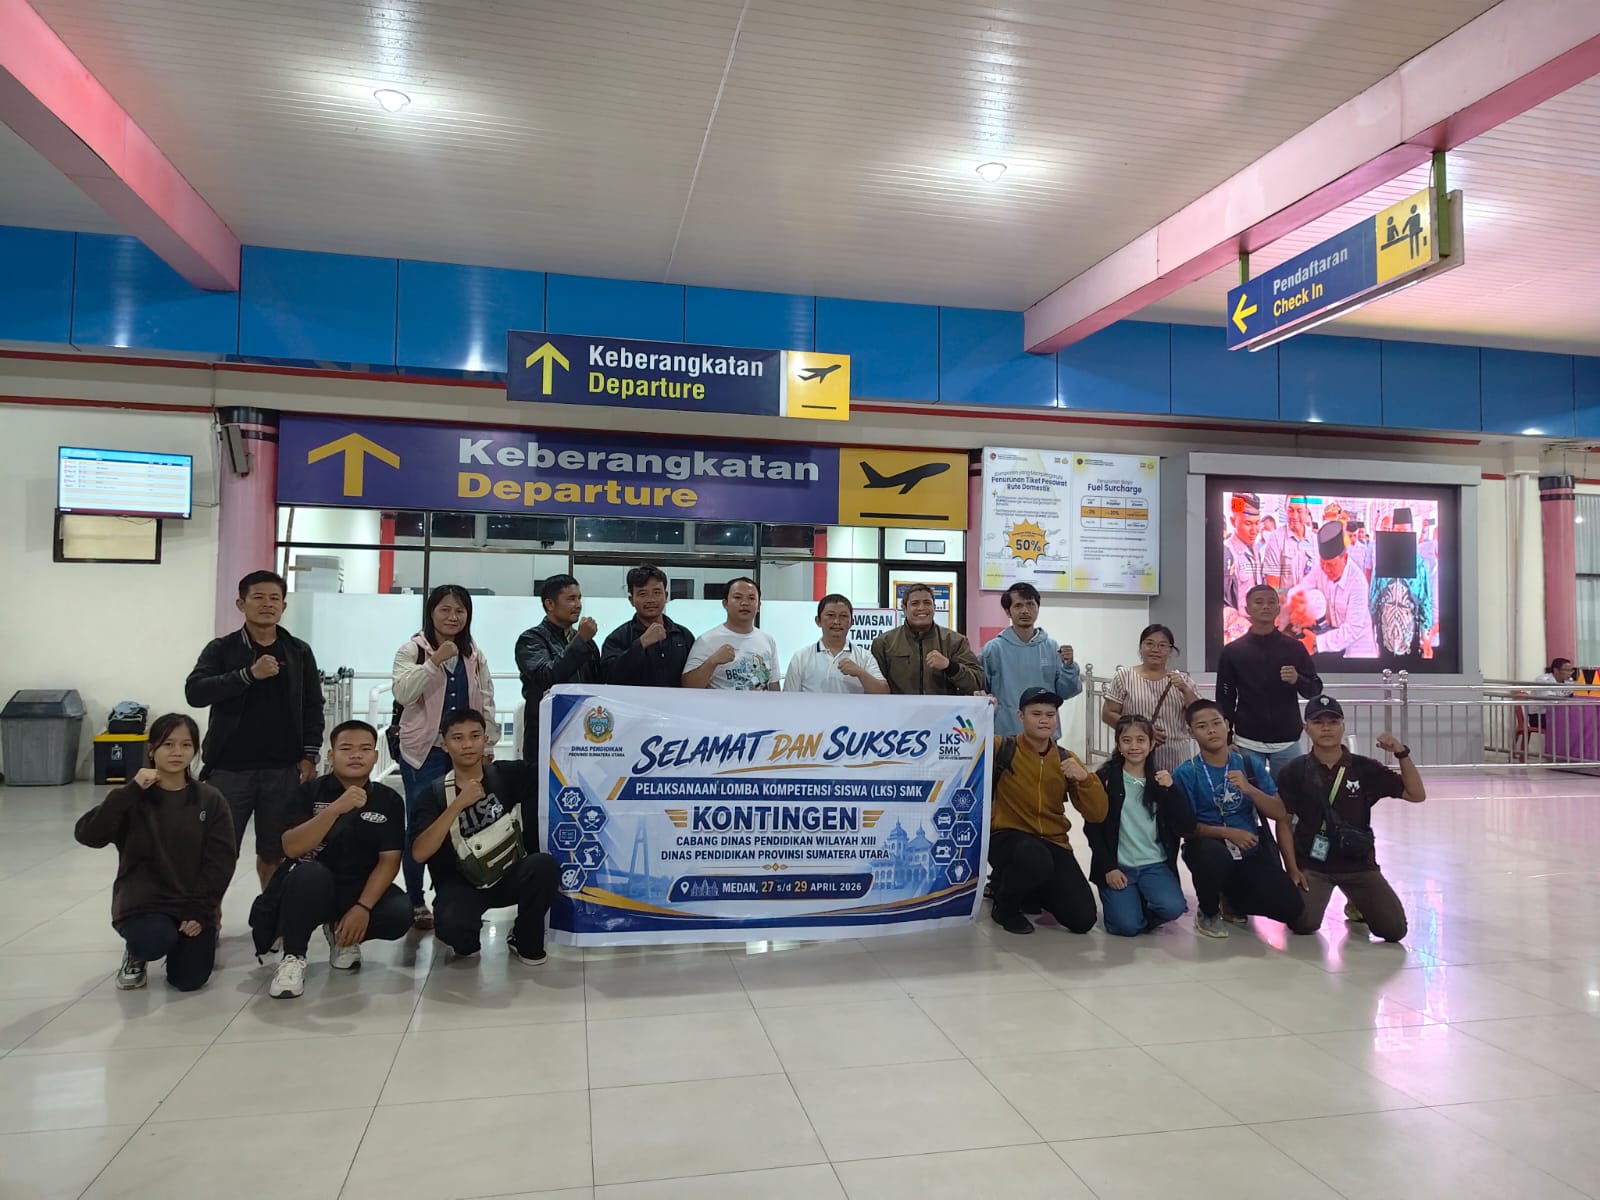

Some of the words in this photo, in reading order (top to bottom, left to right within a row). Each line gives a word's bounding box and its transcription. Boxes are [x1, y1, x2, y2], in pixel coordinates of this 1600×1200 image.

[1272, 247, 1348, 295] Pendaftaran
[1273, 288, 1309, 317] Check
[1311, 281, 1323, 299] In
[589, 344, 763, 377] Keberangkatan
[588, 372, 705, 400] Departure
[459, 438, 819, 481] Keberangkatan
[458, 472, 698, 508] Departure
[1022, 483, 1051, 492] Domestik
[1087, 483, 1103, 492] Fuel
[1104, 485, 1143, 496] Surcharge
[1016, 539, 1042, 552] 50%
[939, 733, 961, 745] LKS
[631, 730, 782, 775] SELAMAT
[767, 731, 824, 761] DAN
[823, 726, 931, 761] SUKSES
[939, 746, 961, 755] SMK
[636, 782, 717, 795] PELAKSANAAN
[720, 783, 760, 796] LOMBA
[763, 783, 831, 796] KOMPETENSI
[834, 784, 868, 797] SISWA
[870, 784, 897, 798] (LKS)
[899, 785, 923, 797] SMK
[693, 806, 858, 831] KONTINGEN
[676, 836, 718, 846] CABANG
[721, 836, 752, 846] DINAS
[754, 836, 813, 846] PENDIDIKAN
[815, 836, 858, 846] WILAYAH
[860, 836, 876, 845] XIII
[661, 850, 692, 860] DINAS
[694, 850, 755, 860] PENDIDIKAN
[758, 850, 804, 860] PROVINSI
[806, 849, 856, 859] SUMATERA
[859, 849, 889, 859] UTARA
[722, 882, 759, 894] MEDAN,
[761, 881, 774, 892] 27
[776, 882, 792, 892] s/d
[794, 880, 808, 892] 29
[810, 882, 838, 891] APRIL
[840, 882, 862, 891] 2026
